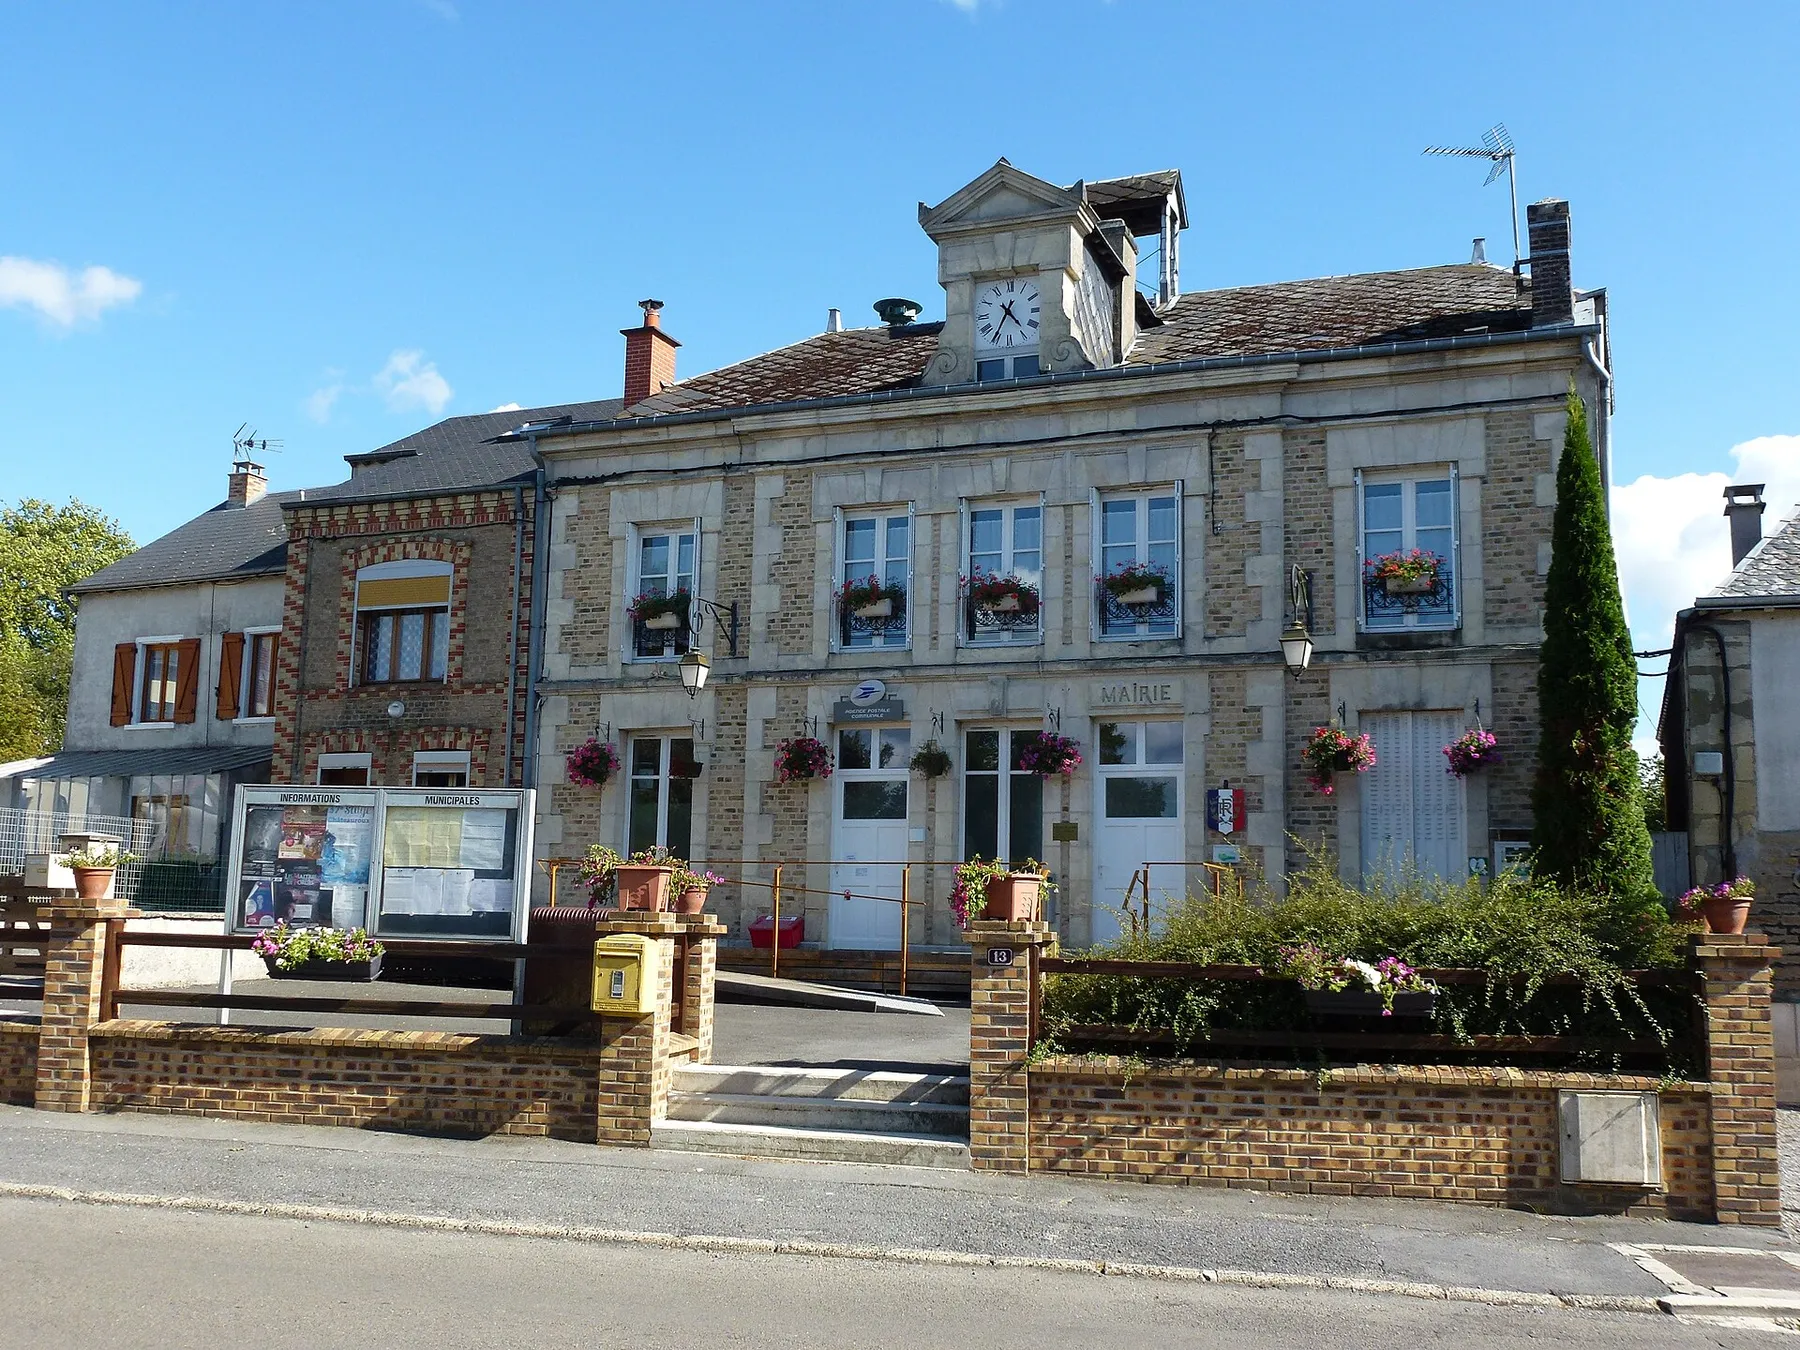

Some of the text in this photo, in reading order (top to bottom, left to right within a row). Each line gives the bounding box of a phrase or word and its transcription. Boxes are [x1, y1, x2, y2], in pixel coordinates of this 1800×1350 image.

[1102, 683, 1171, 703] MAIRIE
[280, 793, 341, 803] INFORMATIONS
[424, 795, 480, 805] MUNICIPALES
[993, 951, 1008, 963] 13
